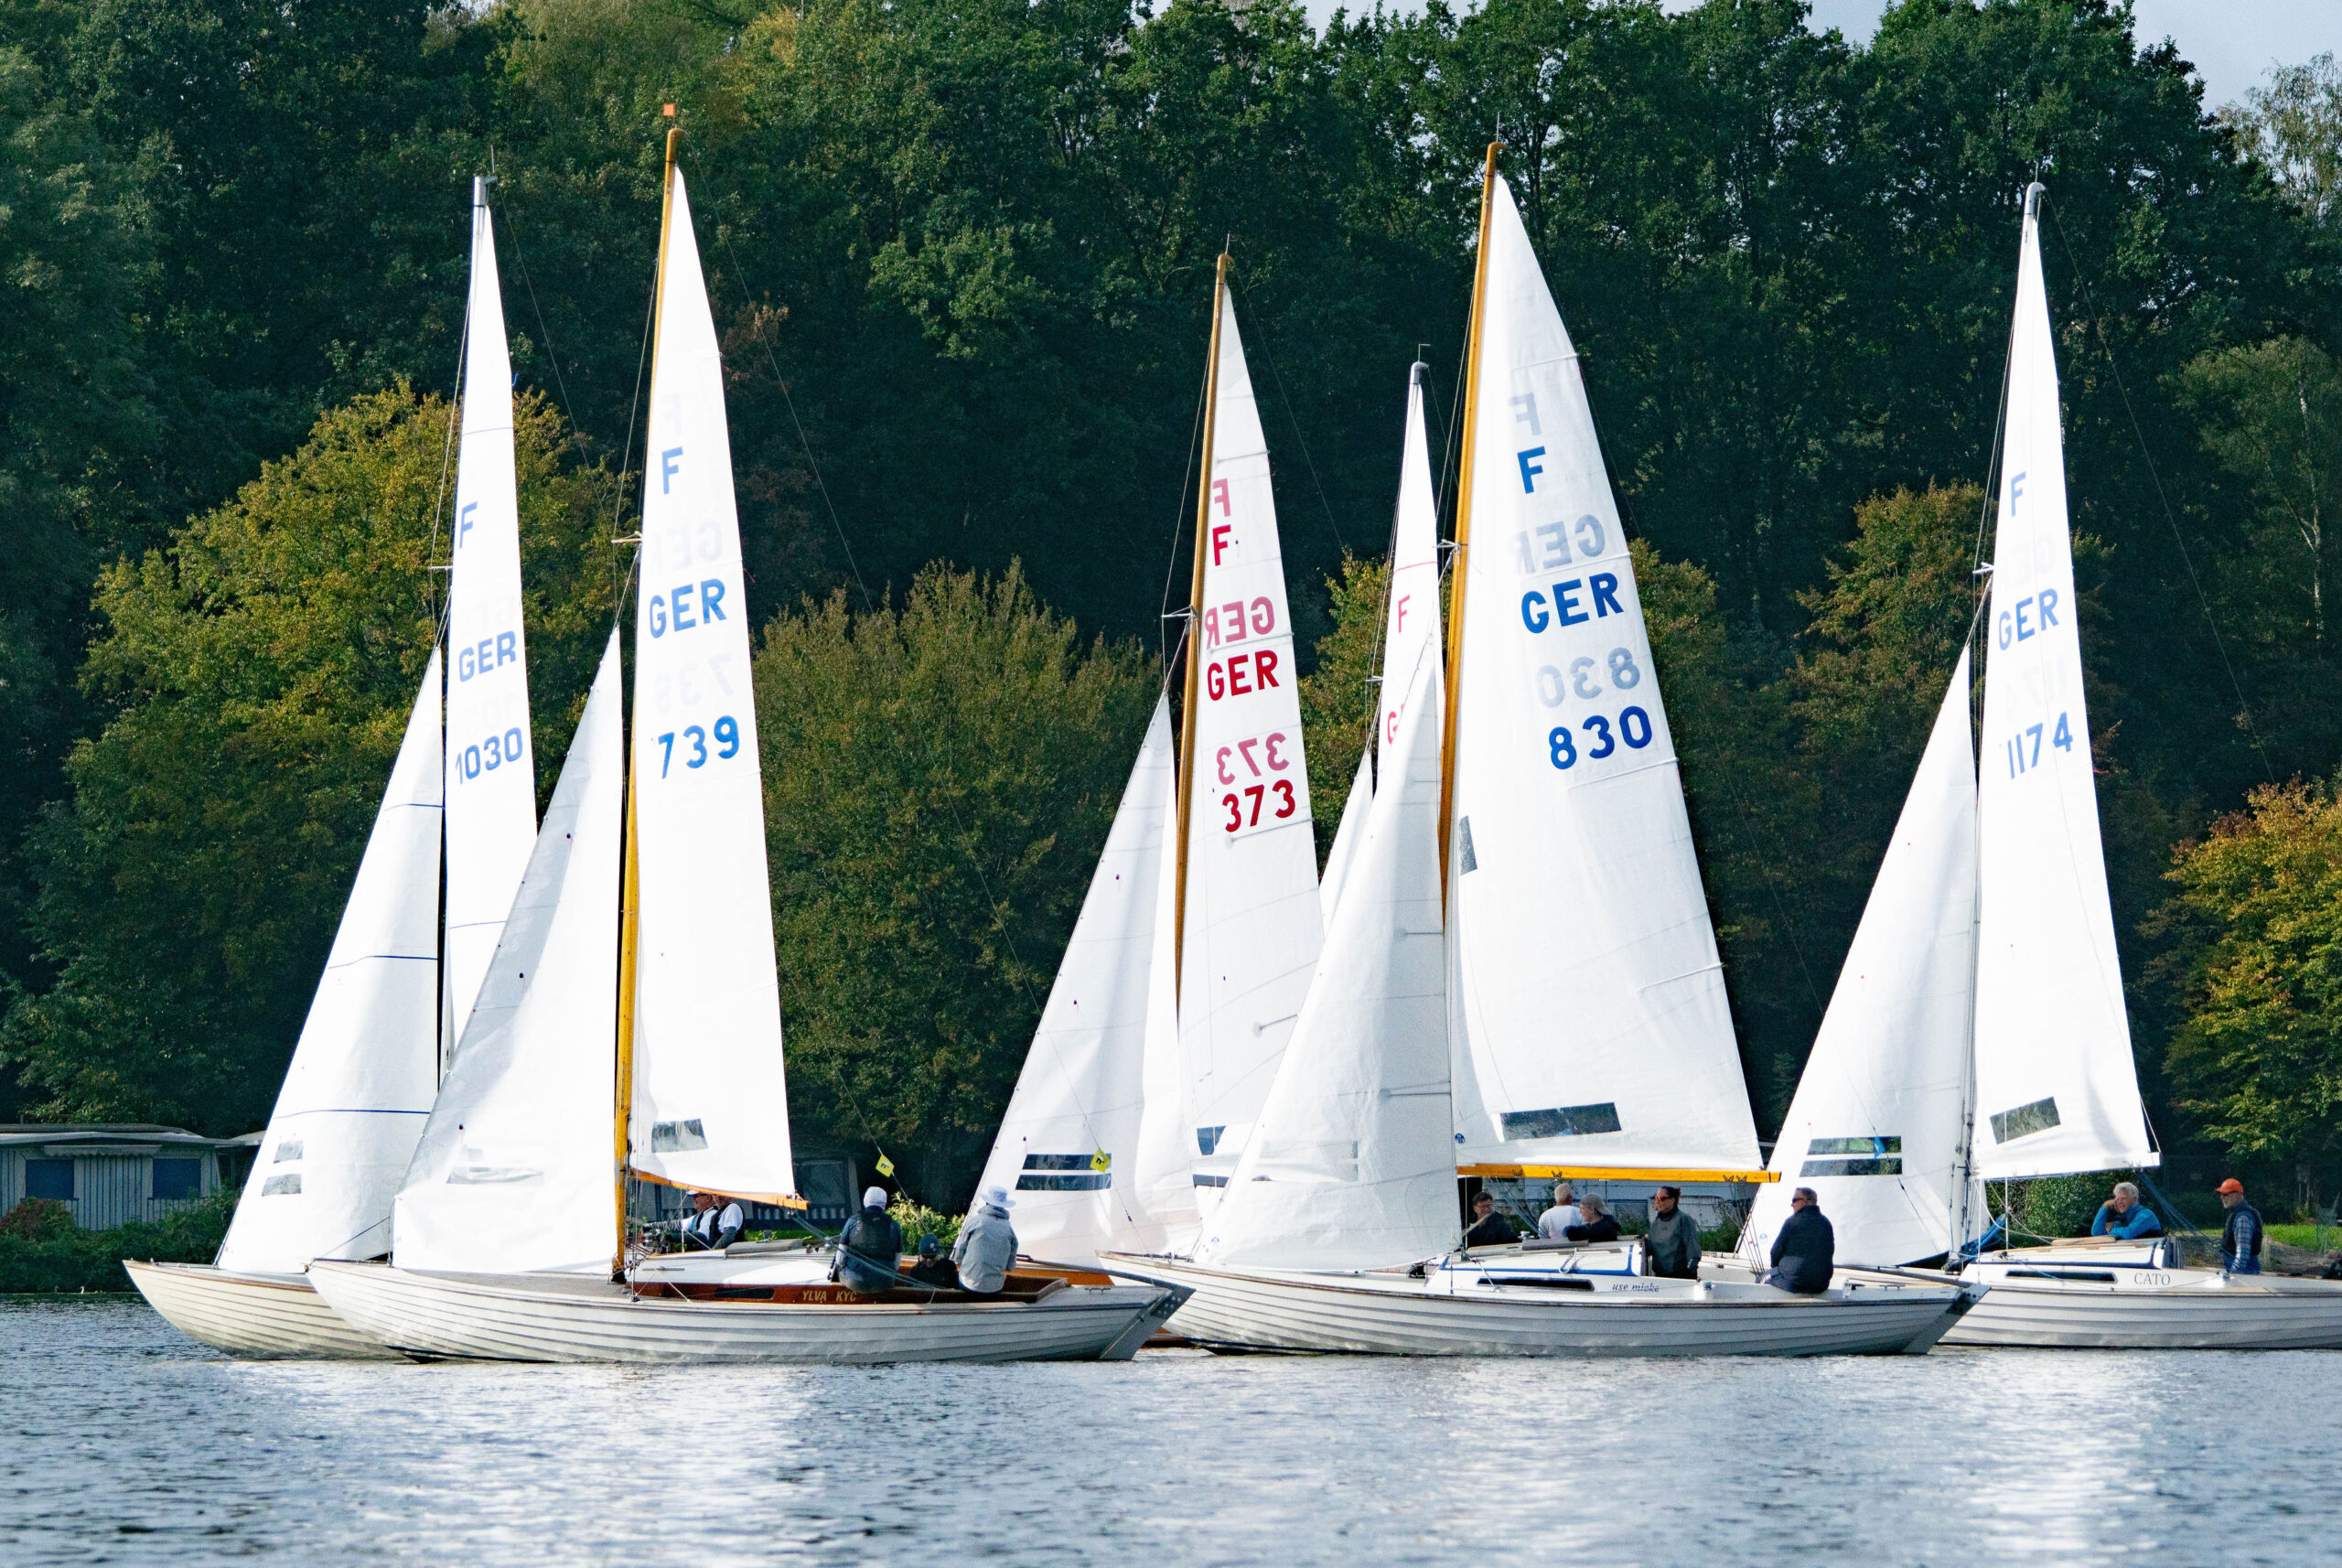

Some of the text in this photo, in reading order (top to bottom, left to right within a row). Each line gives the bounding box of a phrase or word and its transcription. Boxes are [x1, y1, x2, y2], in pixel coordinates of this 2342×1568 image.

[662, 447, 682, 494] F
[1518, 446, 1545, 493] F
[2010, 472, 2026, 517] F
[459, 501, 478, 549] F
[1212, 525, 1231, 566] F
[650, 578, 726, 639] GER
[1399, 596, 1410, 632] F
[1521, 573, 1623, 634] GER
[2000, 589, 2058, 650] GER
[459, 631, 516, 682] GER
[1208, 650, 1279, 701] GER
[456, 727, 522, 783] 1030
[659, 715, 739, 779] 739
[1549, 705, 1652, 769] 830
[2008, 713, 2073, 779] 1174
[1221, 779, 1296, 832] 373
[802, 1290, 856, 1302] YLVA KYC
[2133, 1273, 2171, 1286] CATO
